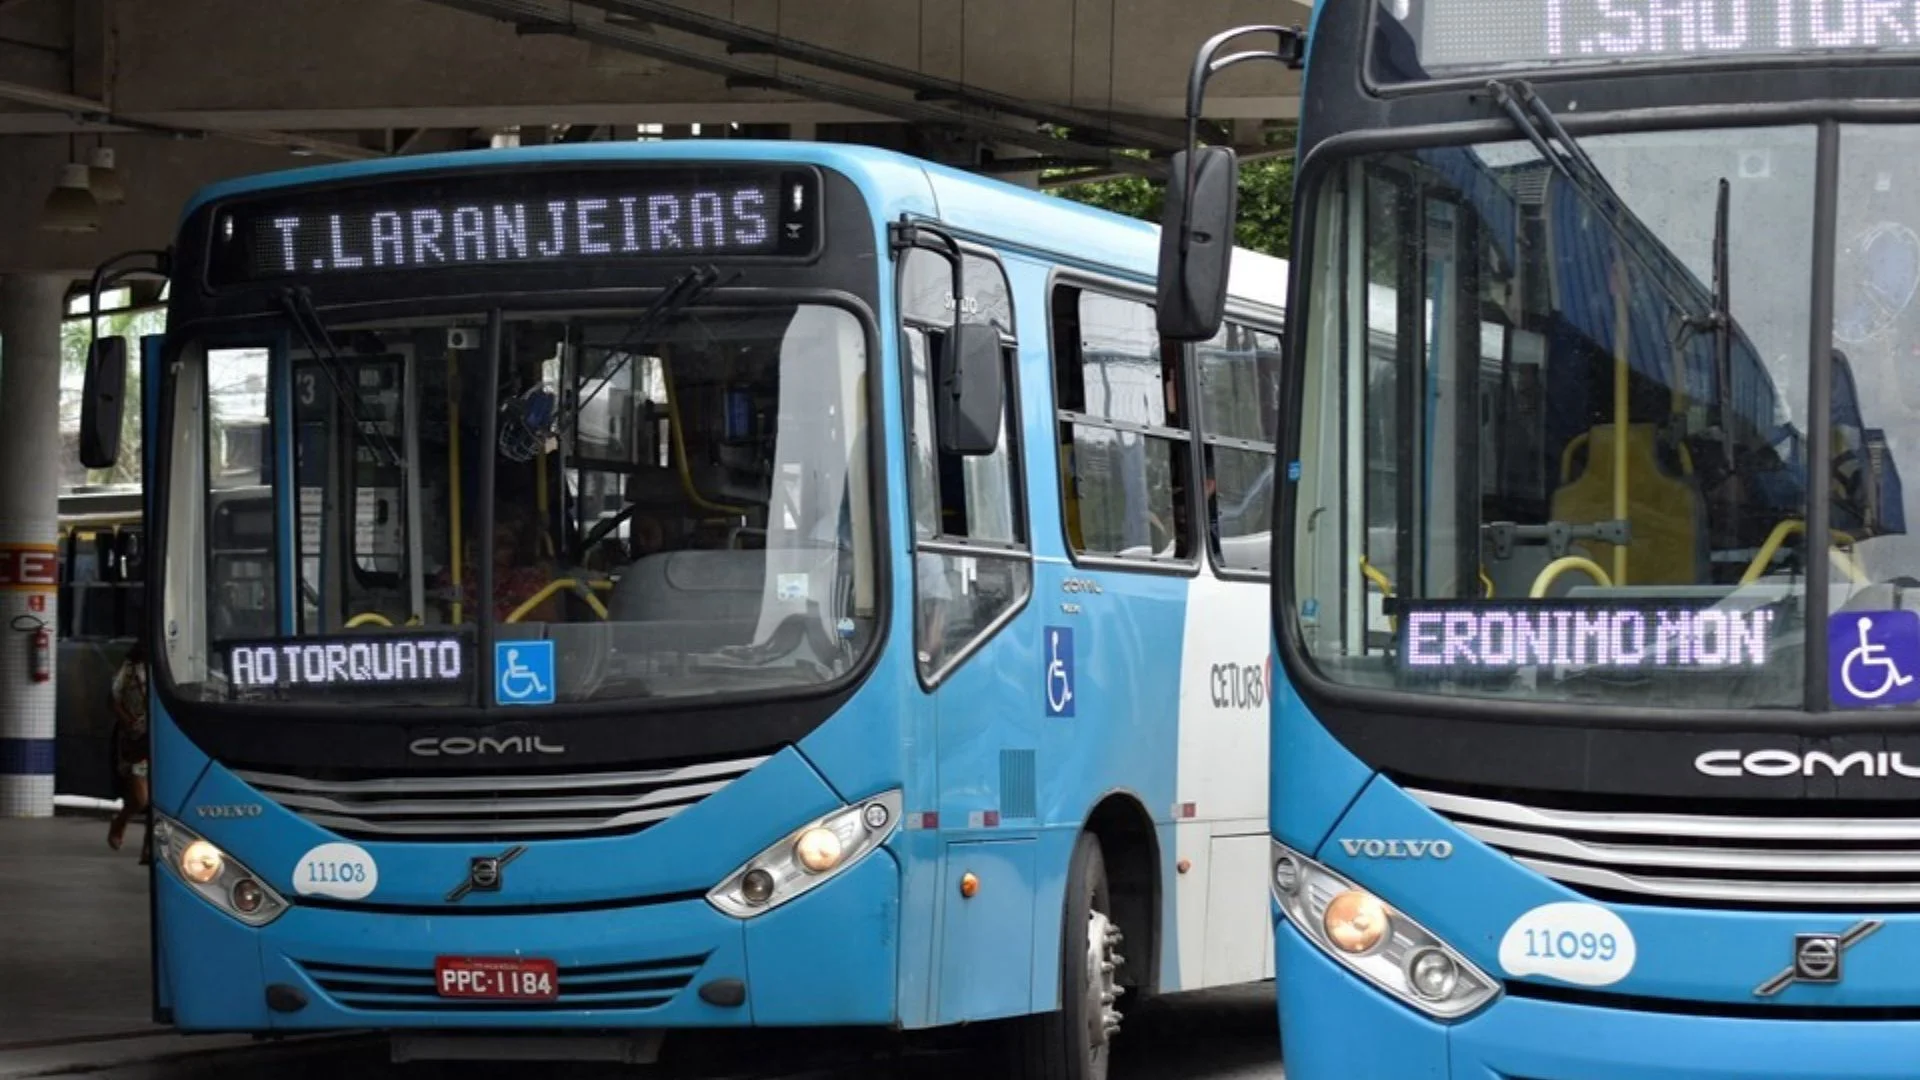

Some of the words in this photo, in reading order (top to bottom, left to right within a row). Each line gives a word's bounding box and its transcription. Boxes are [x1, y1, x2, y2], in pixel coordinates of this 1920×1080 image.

[273, 189, 768, 271] T.LARANJEIRAS
[1407, 611, 1645, 665] ERONIMO
[1655, 610, 1774, 665] MON
[232, 646, 277, 685] AO
[282, 640, 462, 683] TORQUATO
[1210, 662, 1264, 710] CETURB
[408, 735, 565, 756] COMIL
[1694, 749, 1920, 778] COMIL
[195, 803, 263, 818] VOLVO
[1338, 837, 1453, 859] VOLVO
[307, 861, 367, 883] 11103
[1523, 928, 1617, 961] 11099
